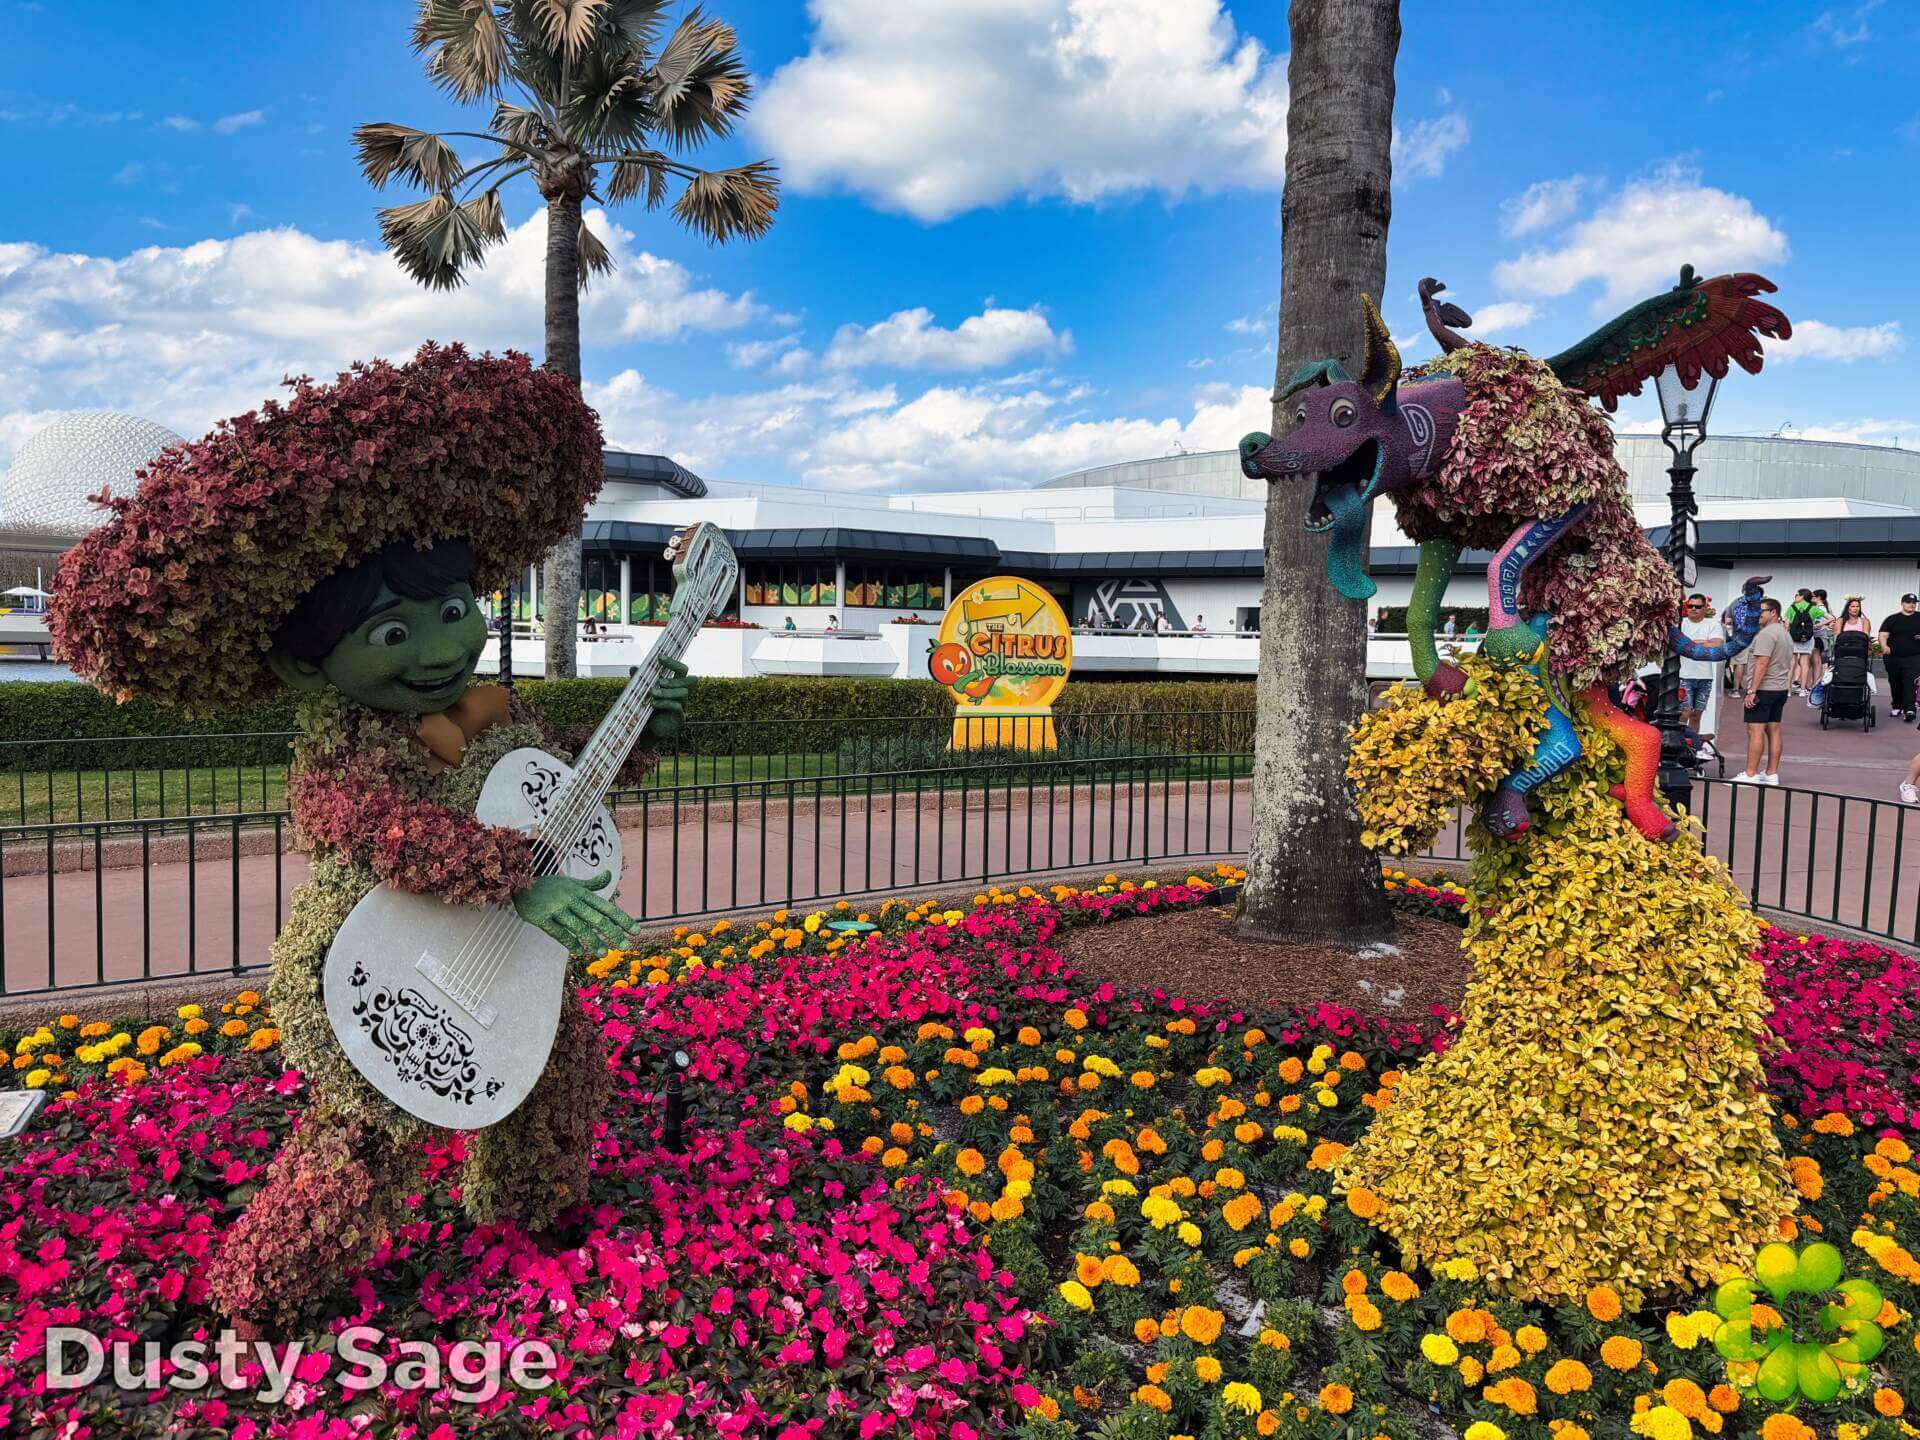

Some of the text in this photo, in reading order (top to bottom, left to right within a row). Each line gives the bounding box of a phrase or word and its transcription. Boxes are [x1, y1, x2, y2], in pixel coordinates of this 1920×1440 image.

[986, 623, 1004, 631] THE
[970, 631, 1067, 659] CITRUS
[983, 652, 1065, 676] Blossom
